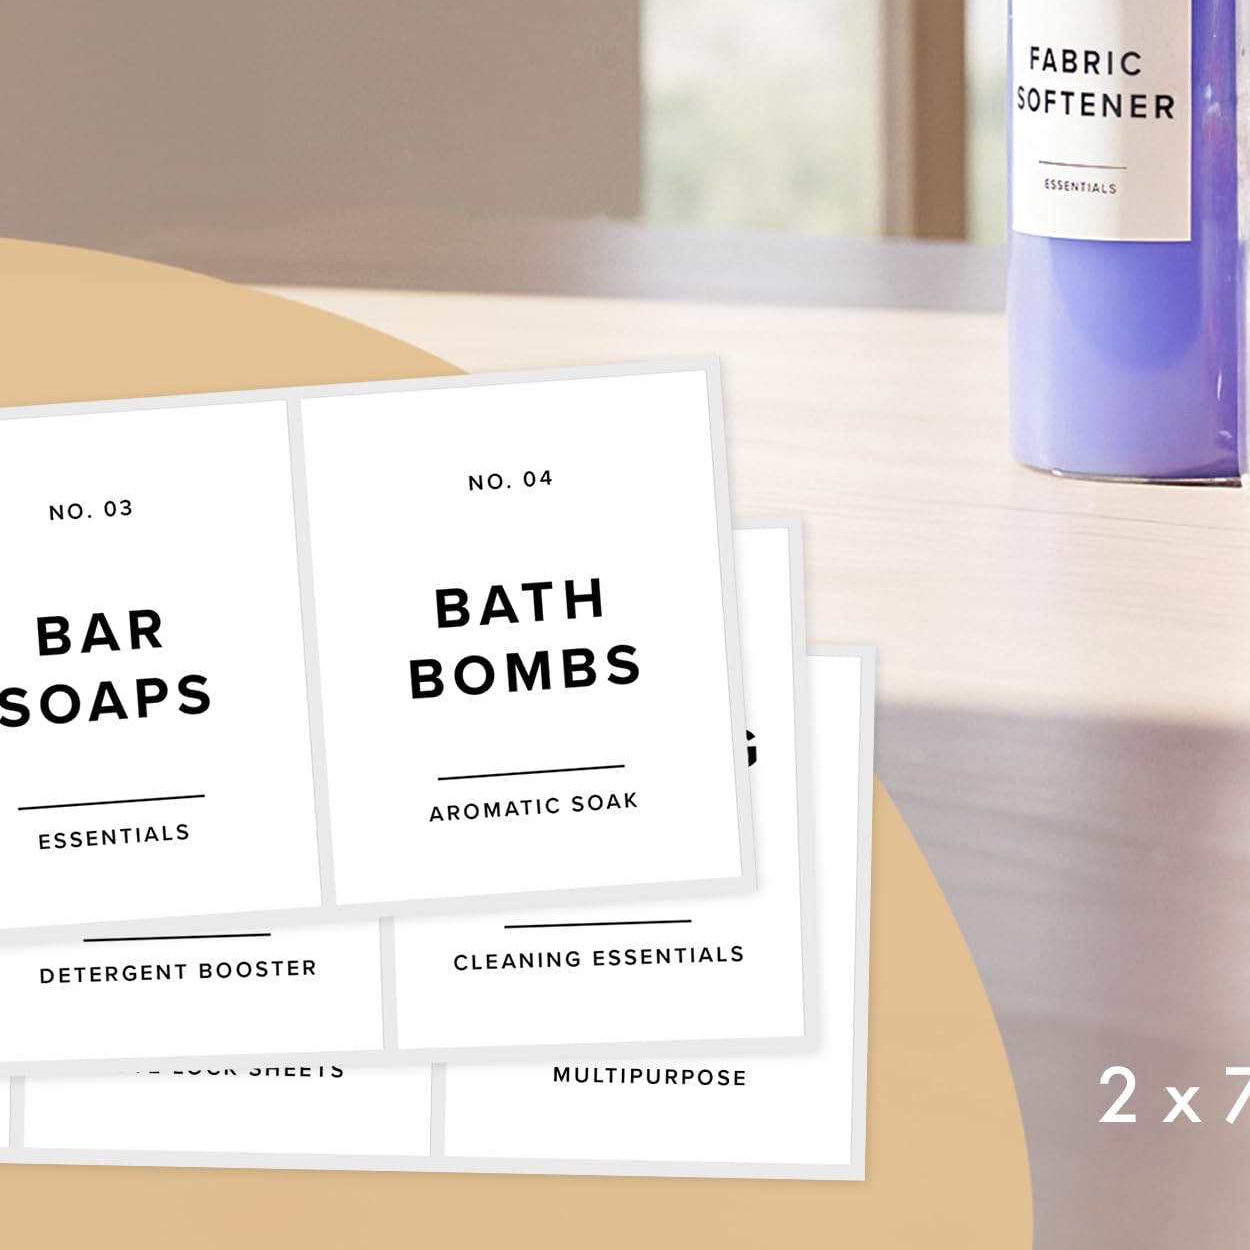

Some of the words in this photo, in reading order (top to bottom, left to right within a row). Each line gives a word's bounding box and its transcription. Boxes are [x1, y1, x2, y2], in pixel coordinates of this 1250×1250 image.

[1030, 45, 1142, 77] FABRIC
[1016, 85, 1175, 120] SOFTENER
[1044, 178, 1118, 195] ESSENTIALS
[468, 472, 512, 491] NO.
[523, 470, 554, 488] 04
[49, 502, 93, 521] NO.
[104, 499, 132, 517] 03
[435, 577, 603, 629] BATH
[37, 609, 163, 656] BAR
[409, 644, 640, 700] BOMBS
[0, 674, 211, 728] SOAPS
[429, 797, 560, 823] AROMATIC
[571, 792, 638, 813] SOAK
[38, 823, 190, 850] ESSENTIALS
[40, 963, 187, 984] DETERGENT
[199, 959, 317, 979] BOOSTER
[453, 950, 581, 972] CLEANING
[592, 945, 744, 967] ESSENTIALS
[553, 1066, 746, 1087] MULTIPURPOSE
